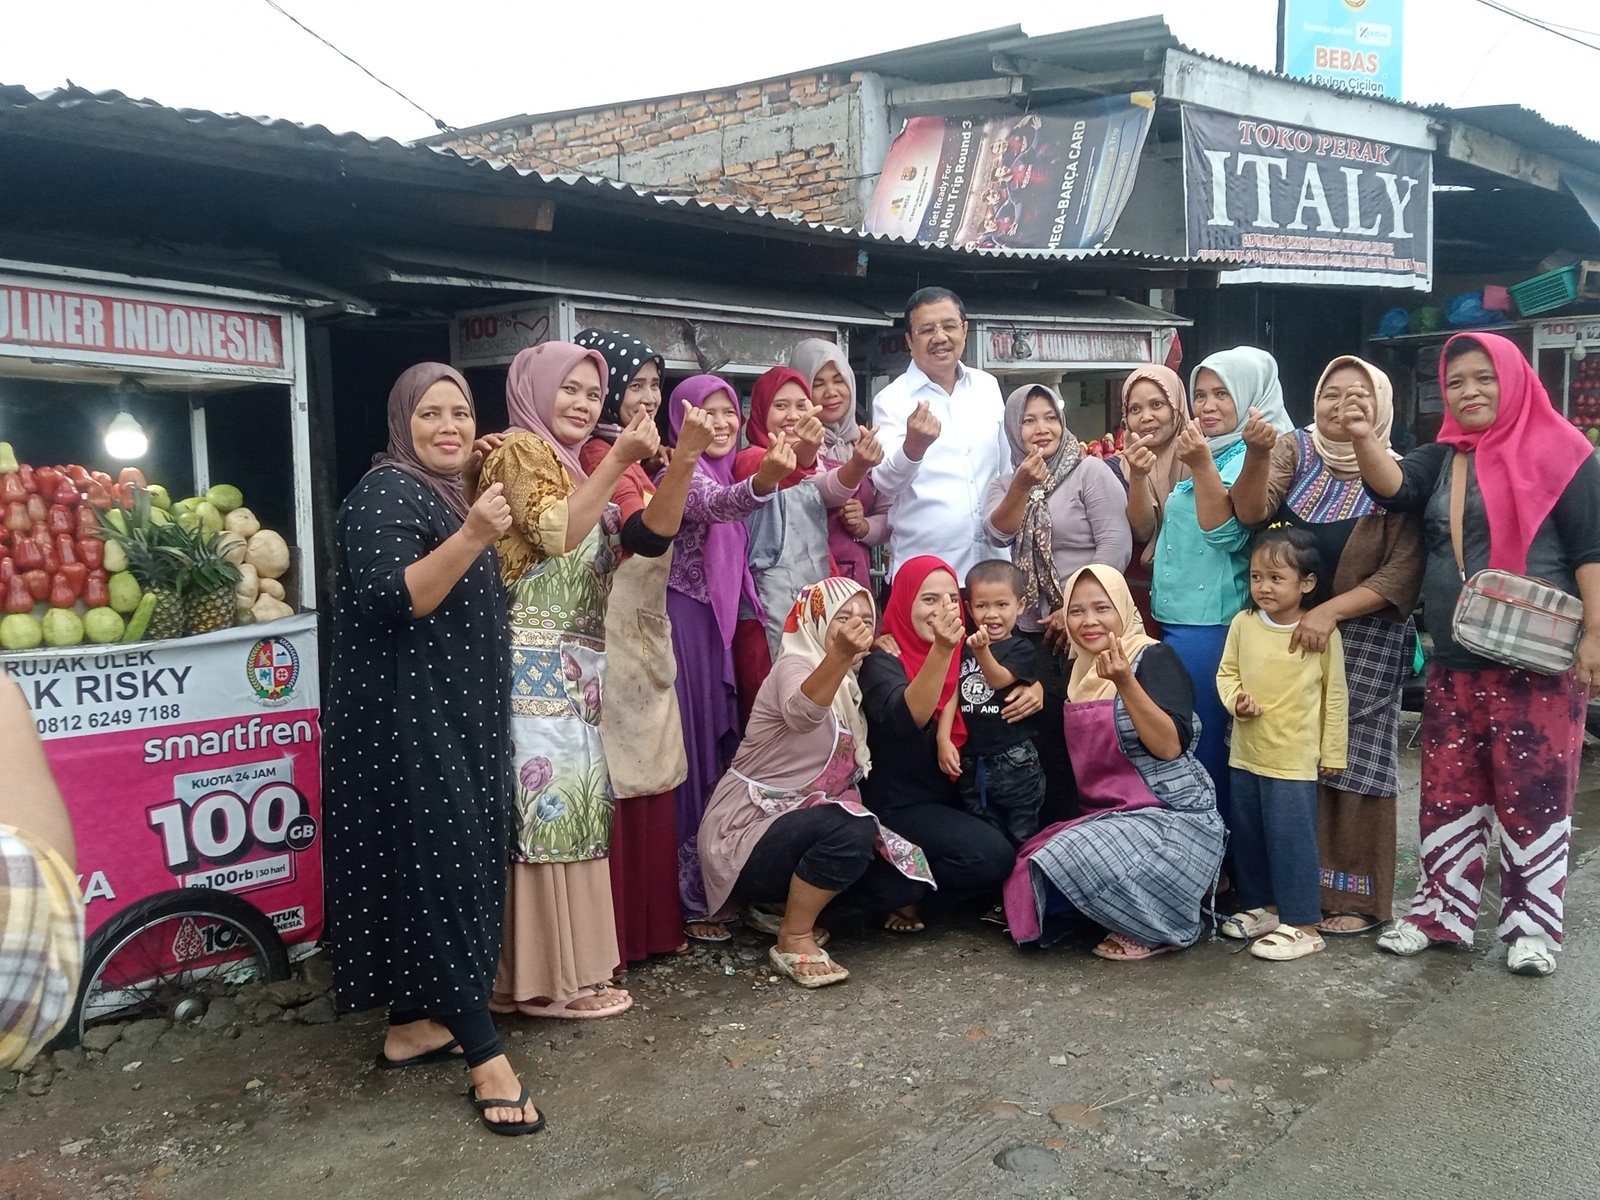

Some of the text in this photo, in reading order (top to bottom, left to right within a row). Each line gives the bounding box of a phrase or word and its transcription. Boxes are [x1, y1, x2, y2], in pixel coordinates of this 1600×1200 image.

[1315, 47, 1378, 74] BEBAS
[1348, 77, 1384, 92] Cicilan
[962, 120, 972, 129] 3
[1068, 120, 1086, 161] CARD
[954, 131, 972, 173] Round
[1238, 120, 1391, 166] TOKO PERAK
[928, 163, 952, 226] Get Ready For
[947, 175, 965, 202] Trip
[1203, 149, 1419, 239] ITALY
[940, 203, 956, 229] Nou
[112, 301, 277, 364] INDONESIA
[4, 650, 156, 678] RUJAK ULEK
[76, 665, 192, 706] RISKY
[36, 703, 181, 734] 0812 6249 7188
[144, 717, 313, 764] smartfren
[191, 767, 277, 790] KUOTA 24 JAM
[149, 786, 314, 867] 100 GB
[259, 868, 270, 877] 30
[270, 863, 286, 874] hari
